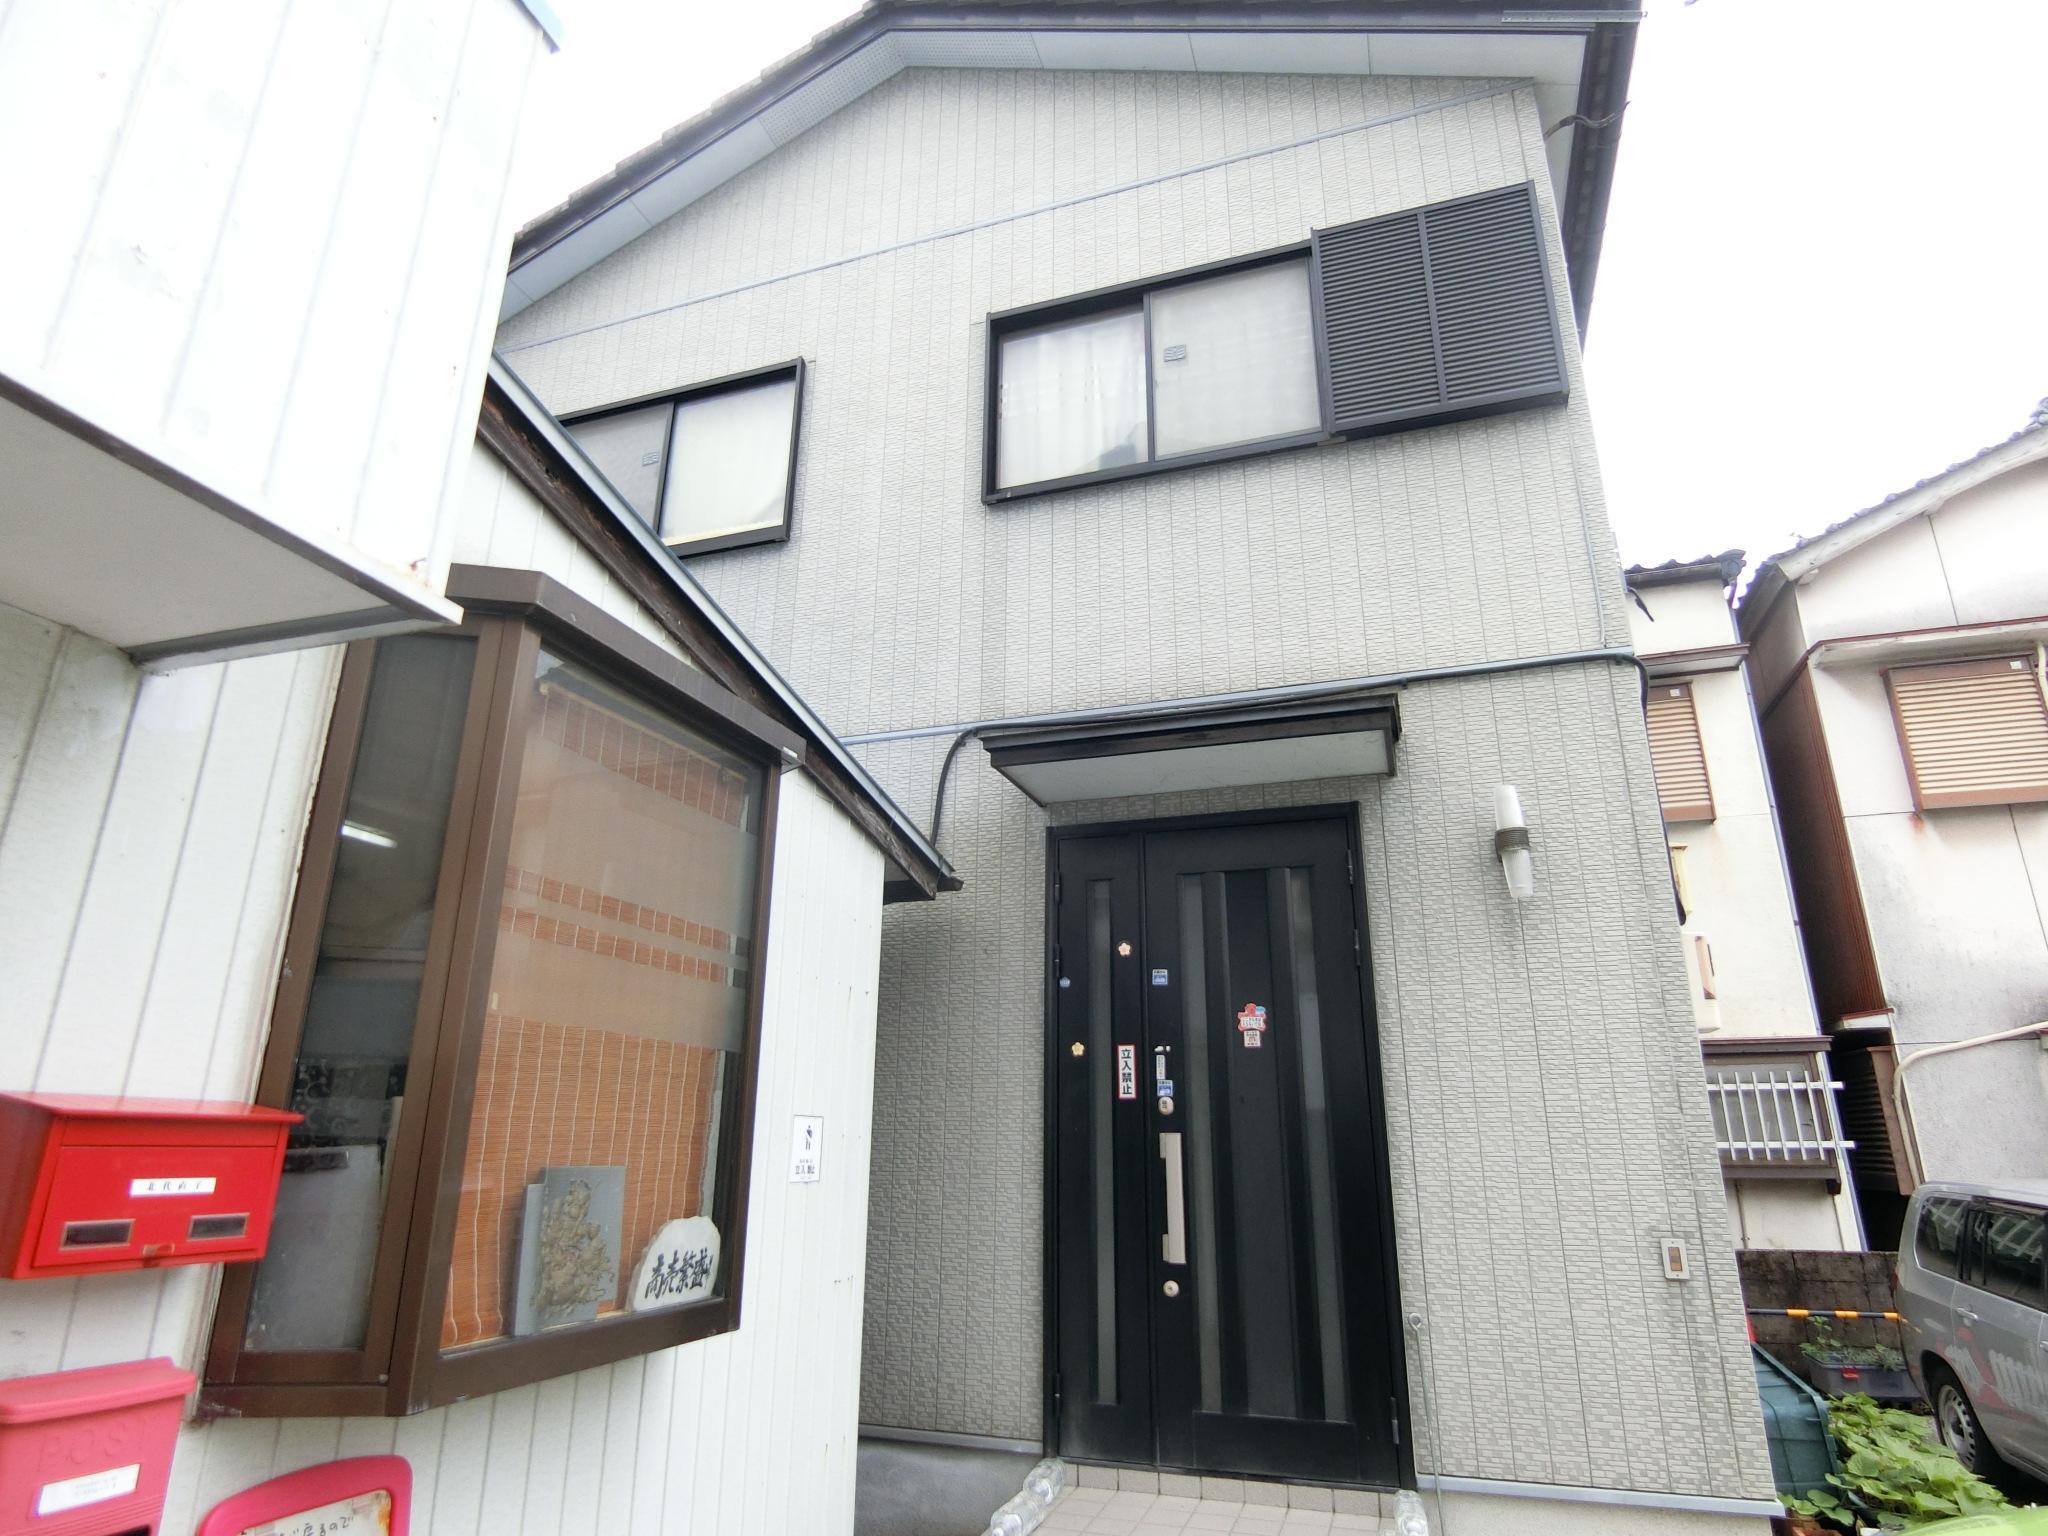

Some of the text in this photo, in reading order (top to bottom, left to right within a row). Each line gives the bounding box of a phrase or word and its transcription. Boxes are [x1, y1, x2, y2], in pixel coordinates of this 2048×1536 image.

[1120, 1048, 1133, 1095] 立入禁止
[645, 1246, 713, 1299] 商売繁盛
